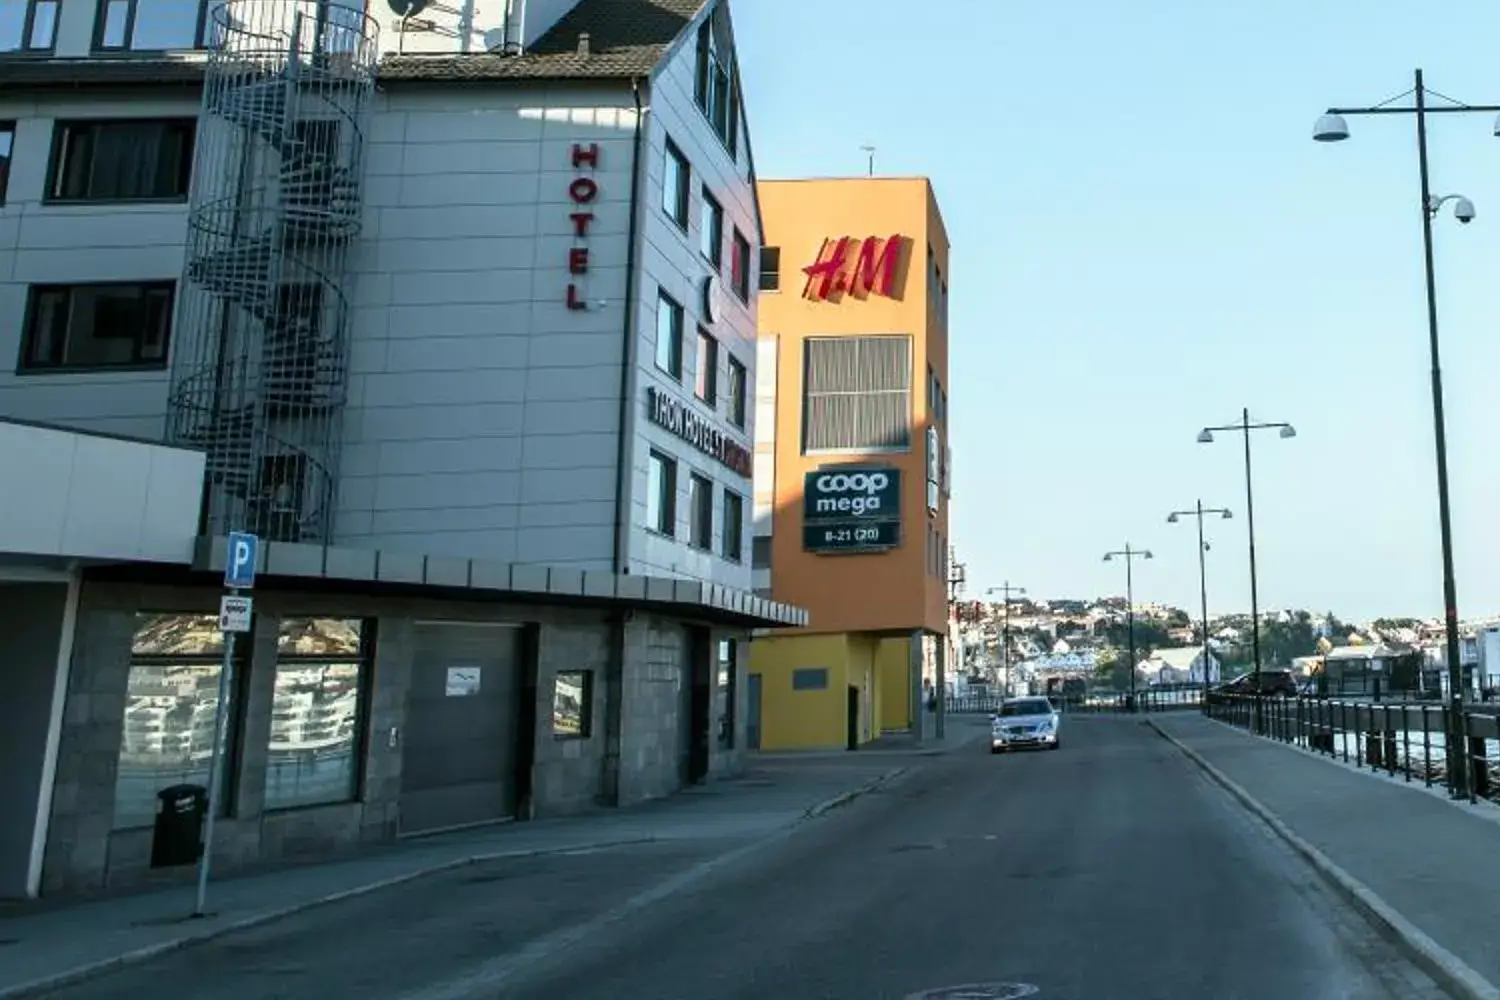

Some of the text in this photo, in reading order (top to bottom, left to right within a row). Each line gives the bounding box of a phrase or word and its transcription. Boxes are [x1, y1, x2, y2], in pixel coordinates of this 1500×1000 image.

[567, 143, 598, 310] HOTEL
[802, 233, 904, 300] H&M
[816, 473, 889, 495] coop
[816, 496, 881, 515] mega
[233, 541, 249, 580] P
